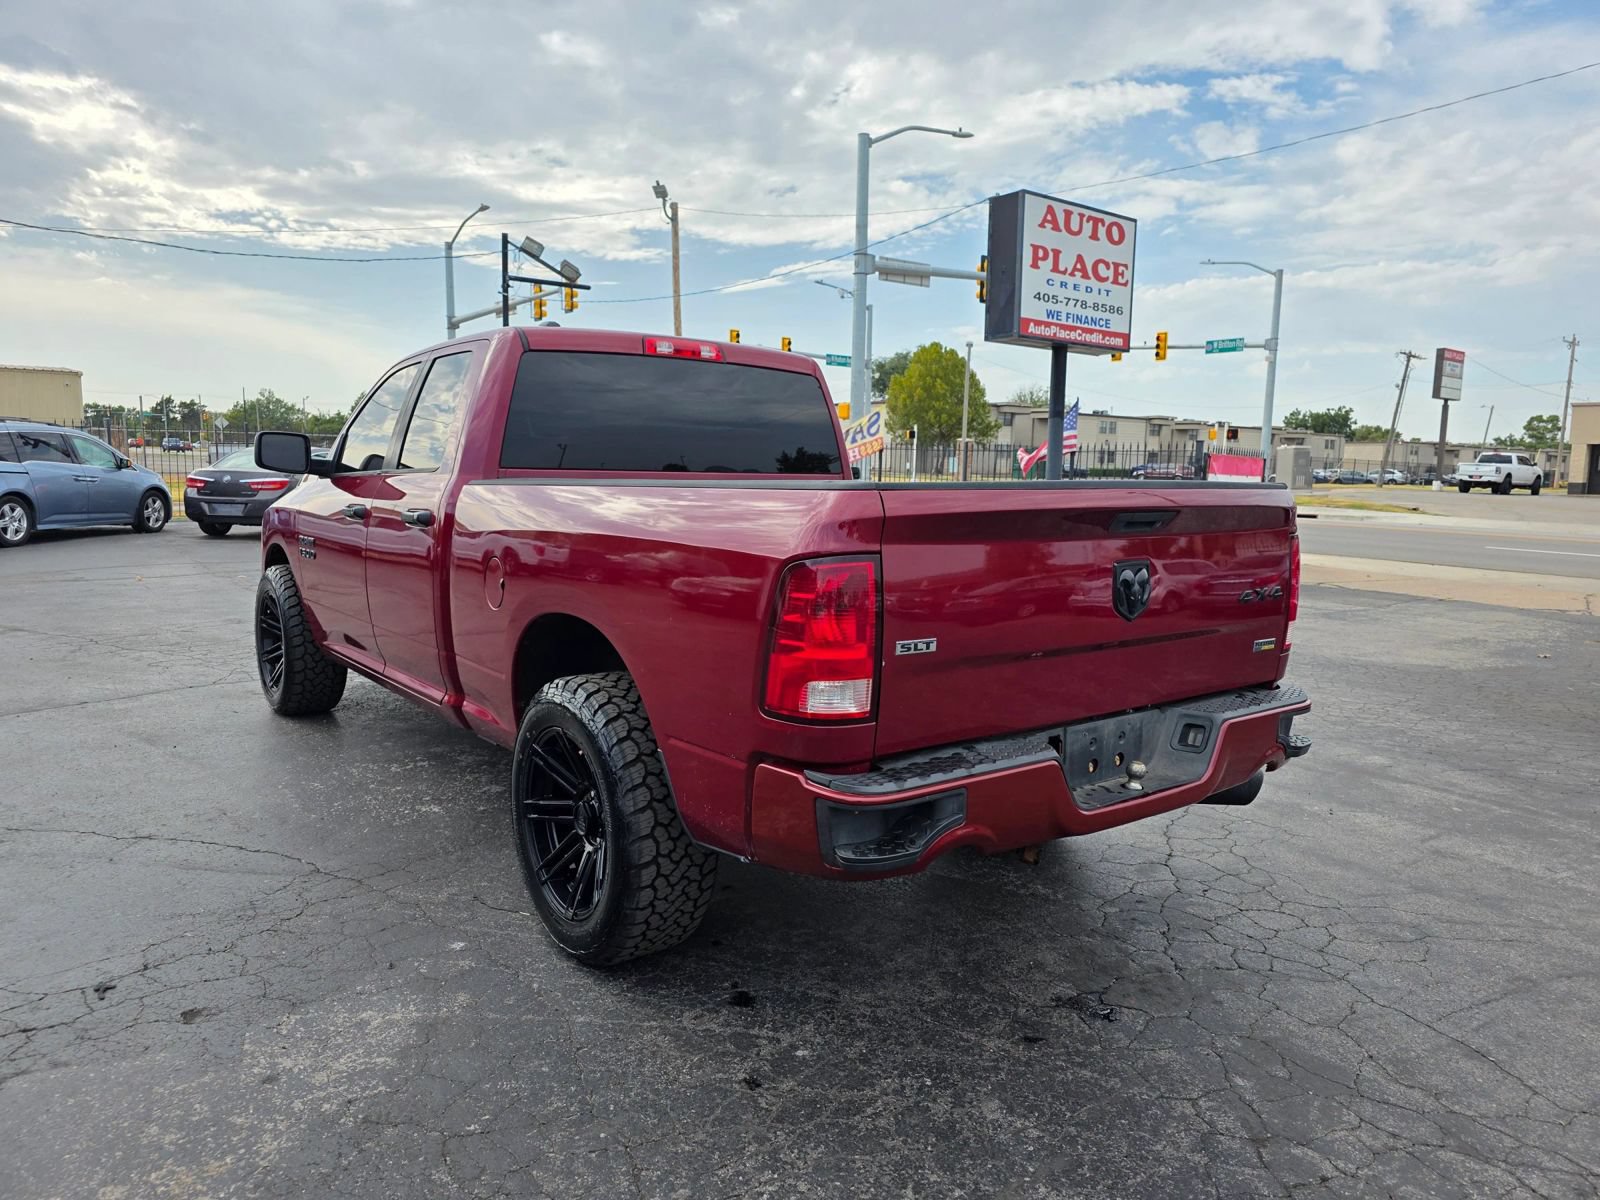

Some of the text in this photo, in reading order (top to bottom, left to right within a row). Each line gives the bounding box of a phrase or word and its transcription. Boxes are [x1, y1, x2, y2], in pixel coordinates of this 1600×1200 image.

[1038, 204, 1126, 246] AUTO
[1030, 243, 1129, 287] PLACE
[1046, 278, 1112, 297] CREDIT
[1033, 291, 1124, 316] 405-778-8586
[1046, 308, 1111, 329] WE FINANCE
[1028, 322, 1124, 346] AutoPlaceCredit.com
[899, 640, 935, 653] SLT
